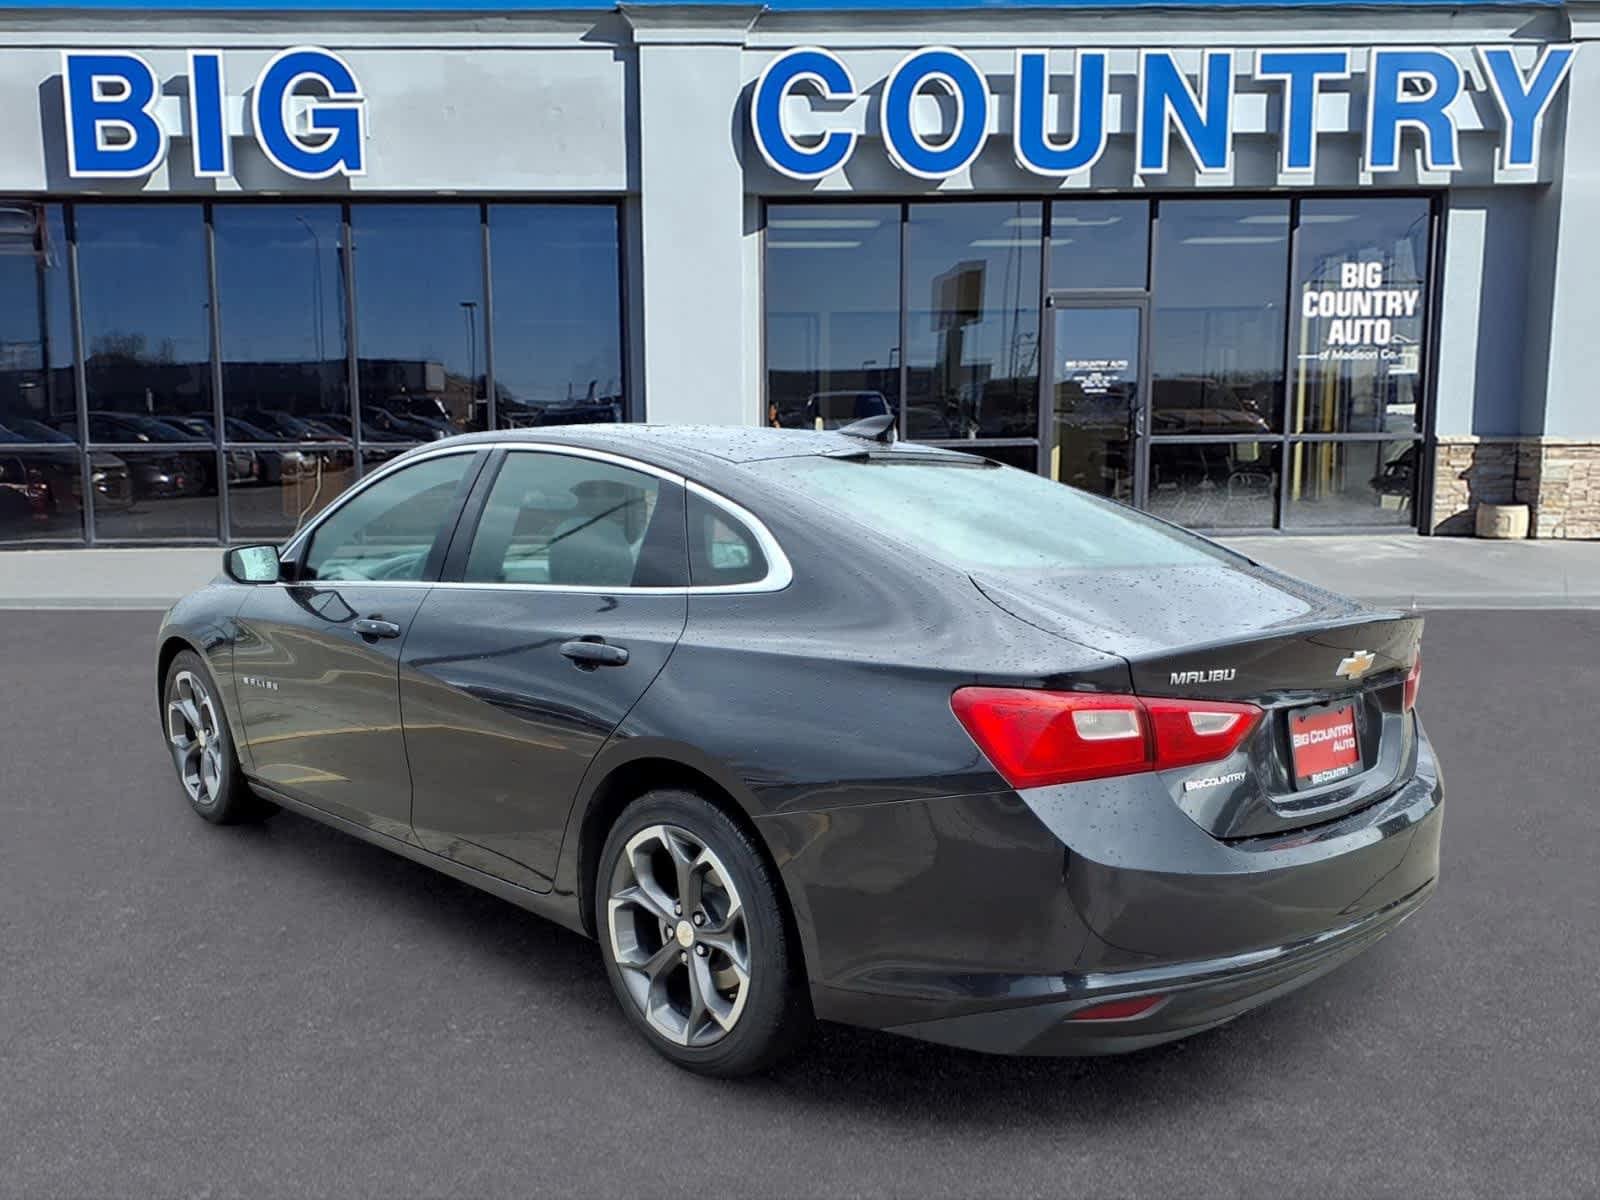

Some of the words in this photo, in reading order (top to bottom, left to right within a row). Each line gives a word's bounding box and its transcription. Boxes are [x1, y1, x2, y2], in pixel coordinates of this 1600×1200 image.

[60, 46, 367, 179] BIG
[751, 45, 1578, 181] COUNTRY
[1341, 262, 1382, 289] BIG
[1303, 290, 1420, 318] COUNTRY
[1328, 319, 1392, 346] AUTO
[1318, 349, 1329, 361] of
[1329, 349, 1378, 361] Madison
[1170, 668, 1236, 686] MALIBU
[1293, 732, 1309, 748] BIG
[1310, 723, 1353, 744] COUNTRY
[1332, 738, 1356, 752] AUTO
[1322, 768, 1348, 782] COUNTRY
